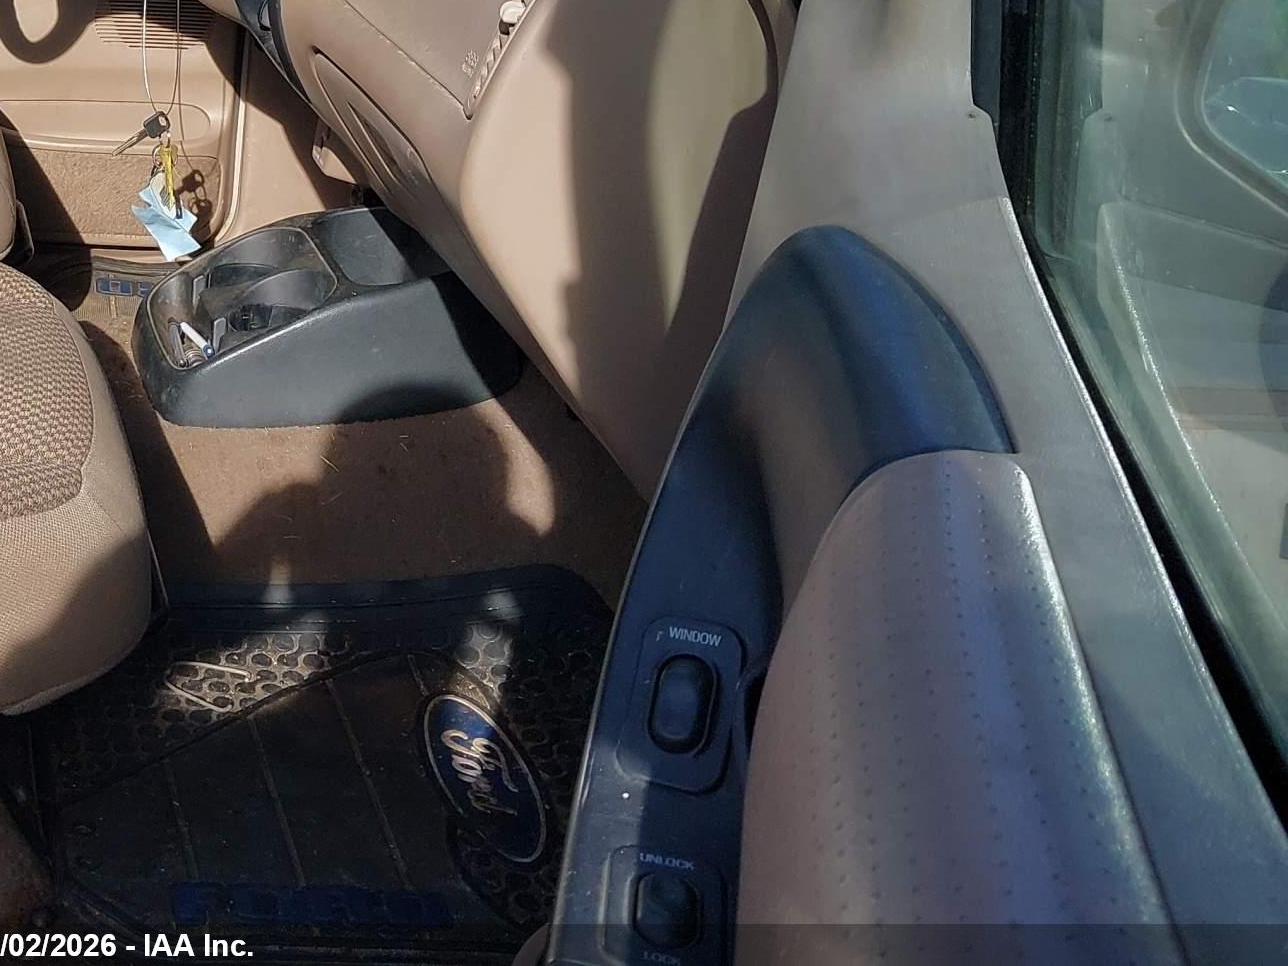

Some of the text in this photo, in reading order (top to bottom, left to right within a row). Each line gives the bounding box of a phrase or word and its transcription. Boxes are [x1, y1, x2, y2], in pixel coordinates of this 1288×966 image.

[669, 625, 722, 647] WINDOW
[441, 729, 519, 816] Ford
[640, 852, 695, 871] UNLOCK
